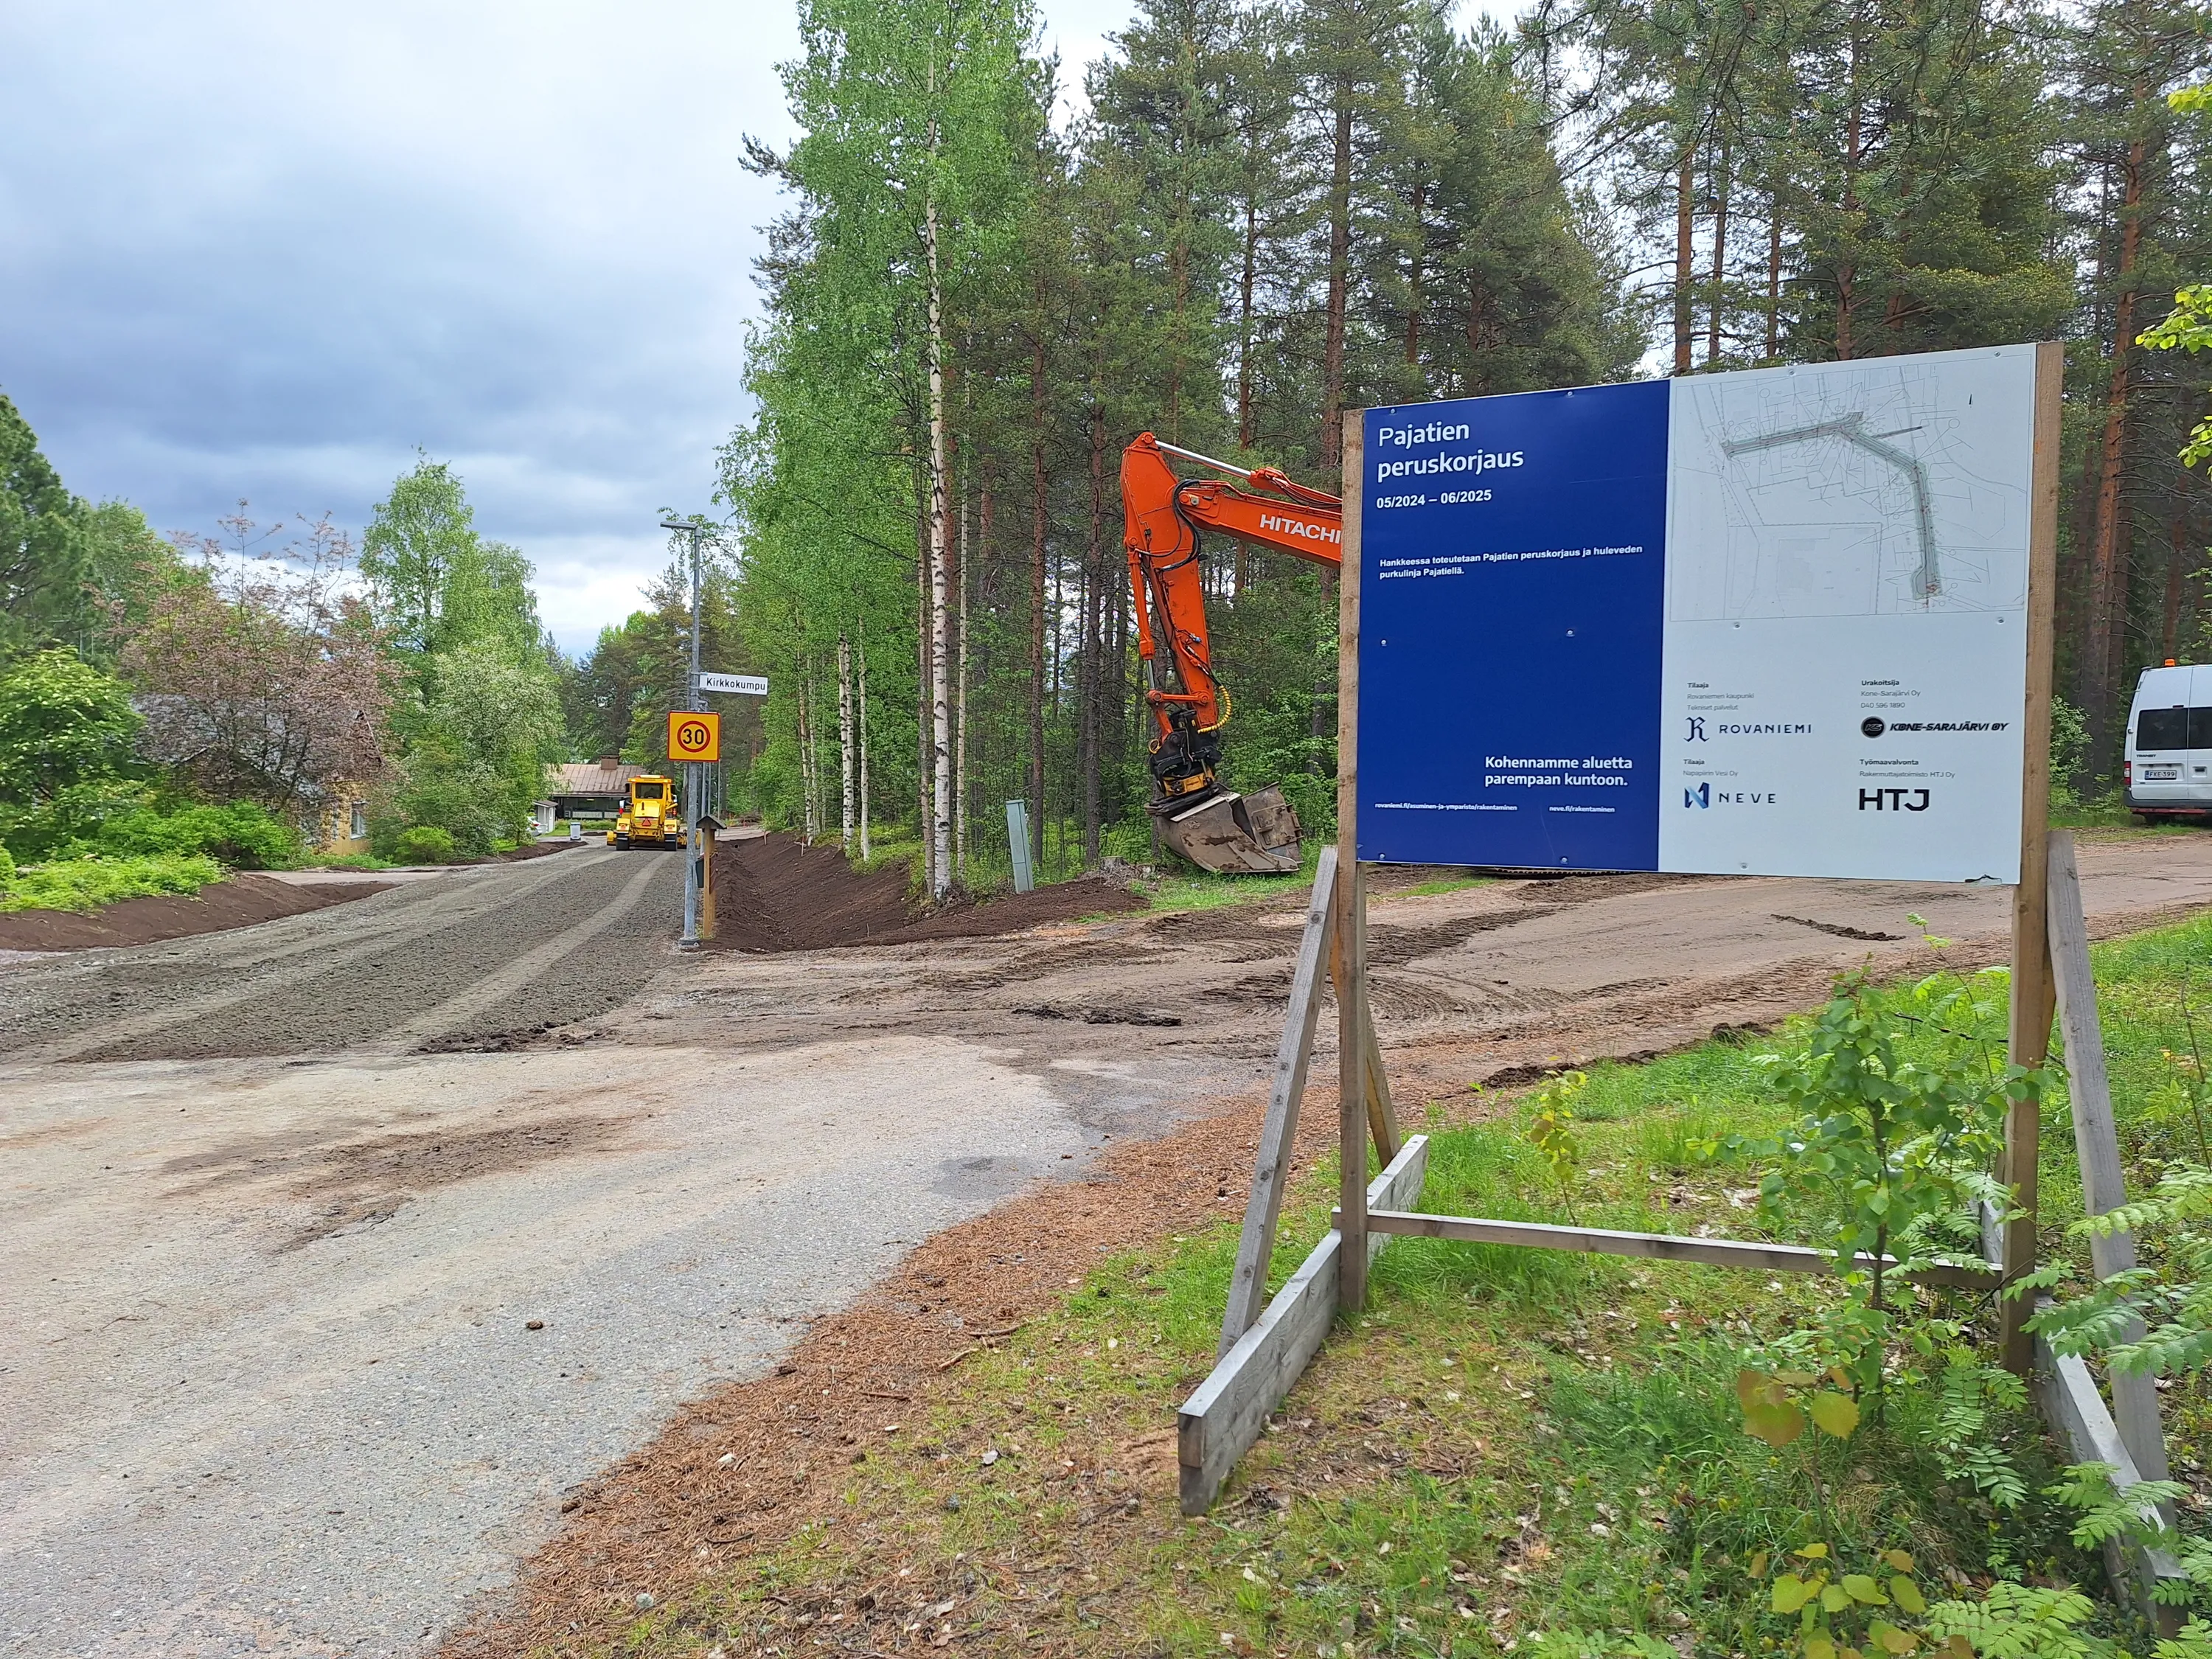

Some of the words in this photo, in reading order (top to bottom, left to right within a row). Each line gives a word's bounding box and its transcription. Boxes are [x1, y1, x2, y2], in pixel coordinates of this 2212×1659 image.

[1378, 421, 1470, 450] Pajatien
[1377, 450, 1524, 483] peruskorjaus
[1376, 494, 1425, 509] 05/2024
[1440, 489, 1492, 505] 06/2025
[1259, 514, 1341, 544] HITACHI
[1380, 556, 1430, 567] Hankkeessa
[1432, 554, 1481, 565] toteutetaan
[1483, 551, 1519, 563] Pajatien
[1520, 549, 1581, 562] peruskorjaus
[1582, 548, 1591, 558] ja
[1593, 545, 1643, 556] huleveden
[1380, 568, 1422, 580] purkulinja
[1423, 566, 1464, 579] Pajatiellä.
[706, 677, 765, 690] Kirkkokumpu
[1719, 724, 1812, 734] ROVANIEMI
[1889, 721, 1990, 731] KONE-SARAJÄRVI
[1992, 723, 2008, 731] OY
[682, 728, 704, 745] 30
[1485, 756, 1579, 770] Kohennamme
[1582, 757, 1632, 770] aluetta
[1484, 774, 1561, 787] parempaan
[1564, 773, 1628, 786] kuntoon.
[1719, 793, 1776, 804] NEVE
[1859, 788, 1930, 811] HTJ
[1549, 805, 1615, 813] neve.fi/rakentaminen
